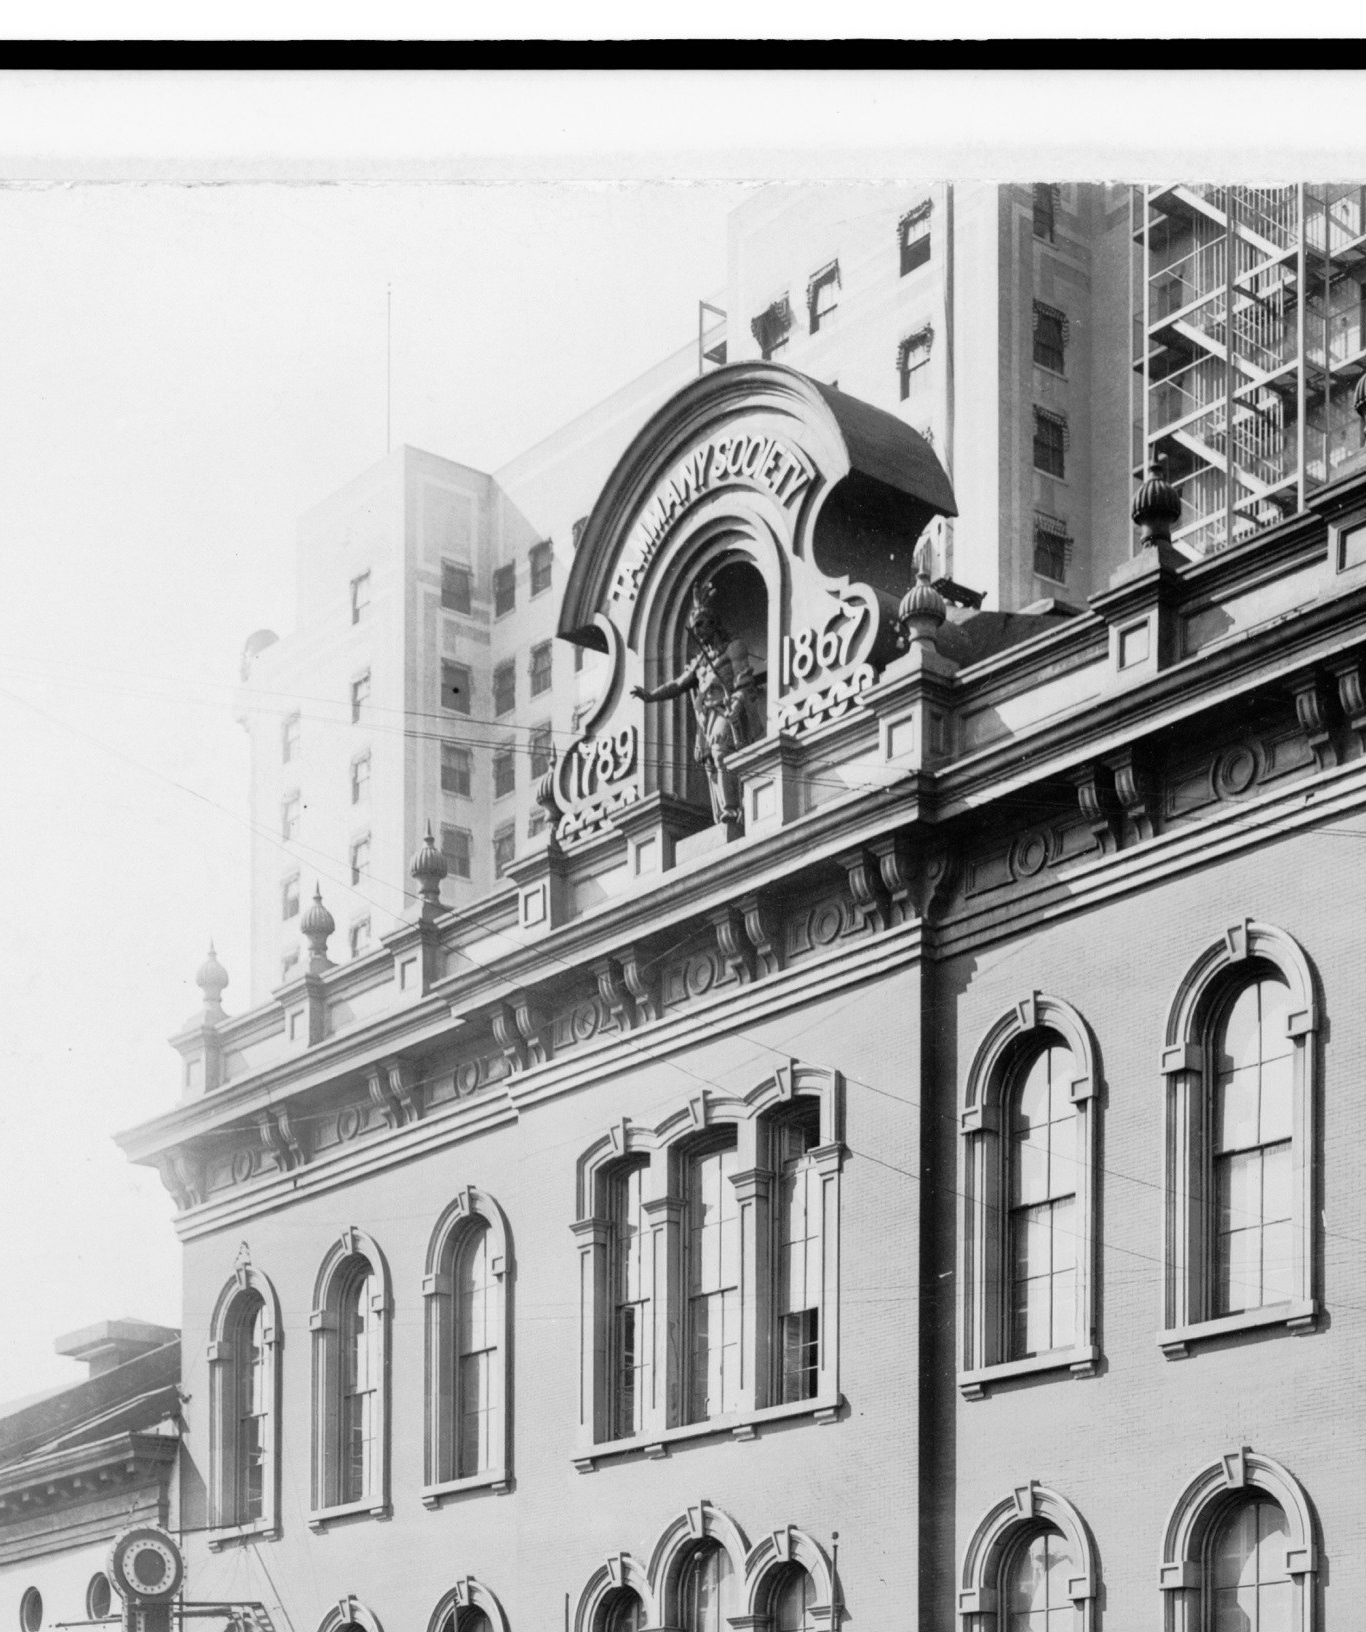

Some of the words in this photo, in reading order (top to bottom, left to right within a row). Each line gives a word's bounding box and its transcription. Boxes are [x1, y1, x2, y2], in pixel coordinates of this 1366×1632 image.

[608, 443, 715, 601] TAMMANY
[711, 434, 810, 508] SOCIETY
[782, 603, 871, 686] 1867
[571, 726, 634, 800] 1789
